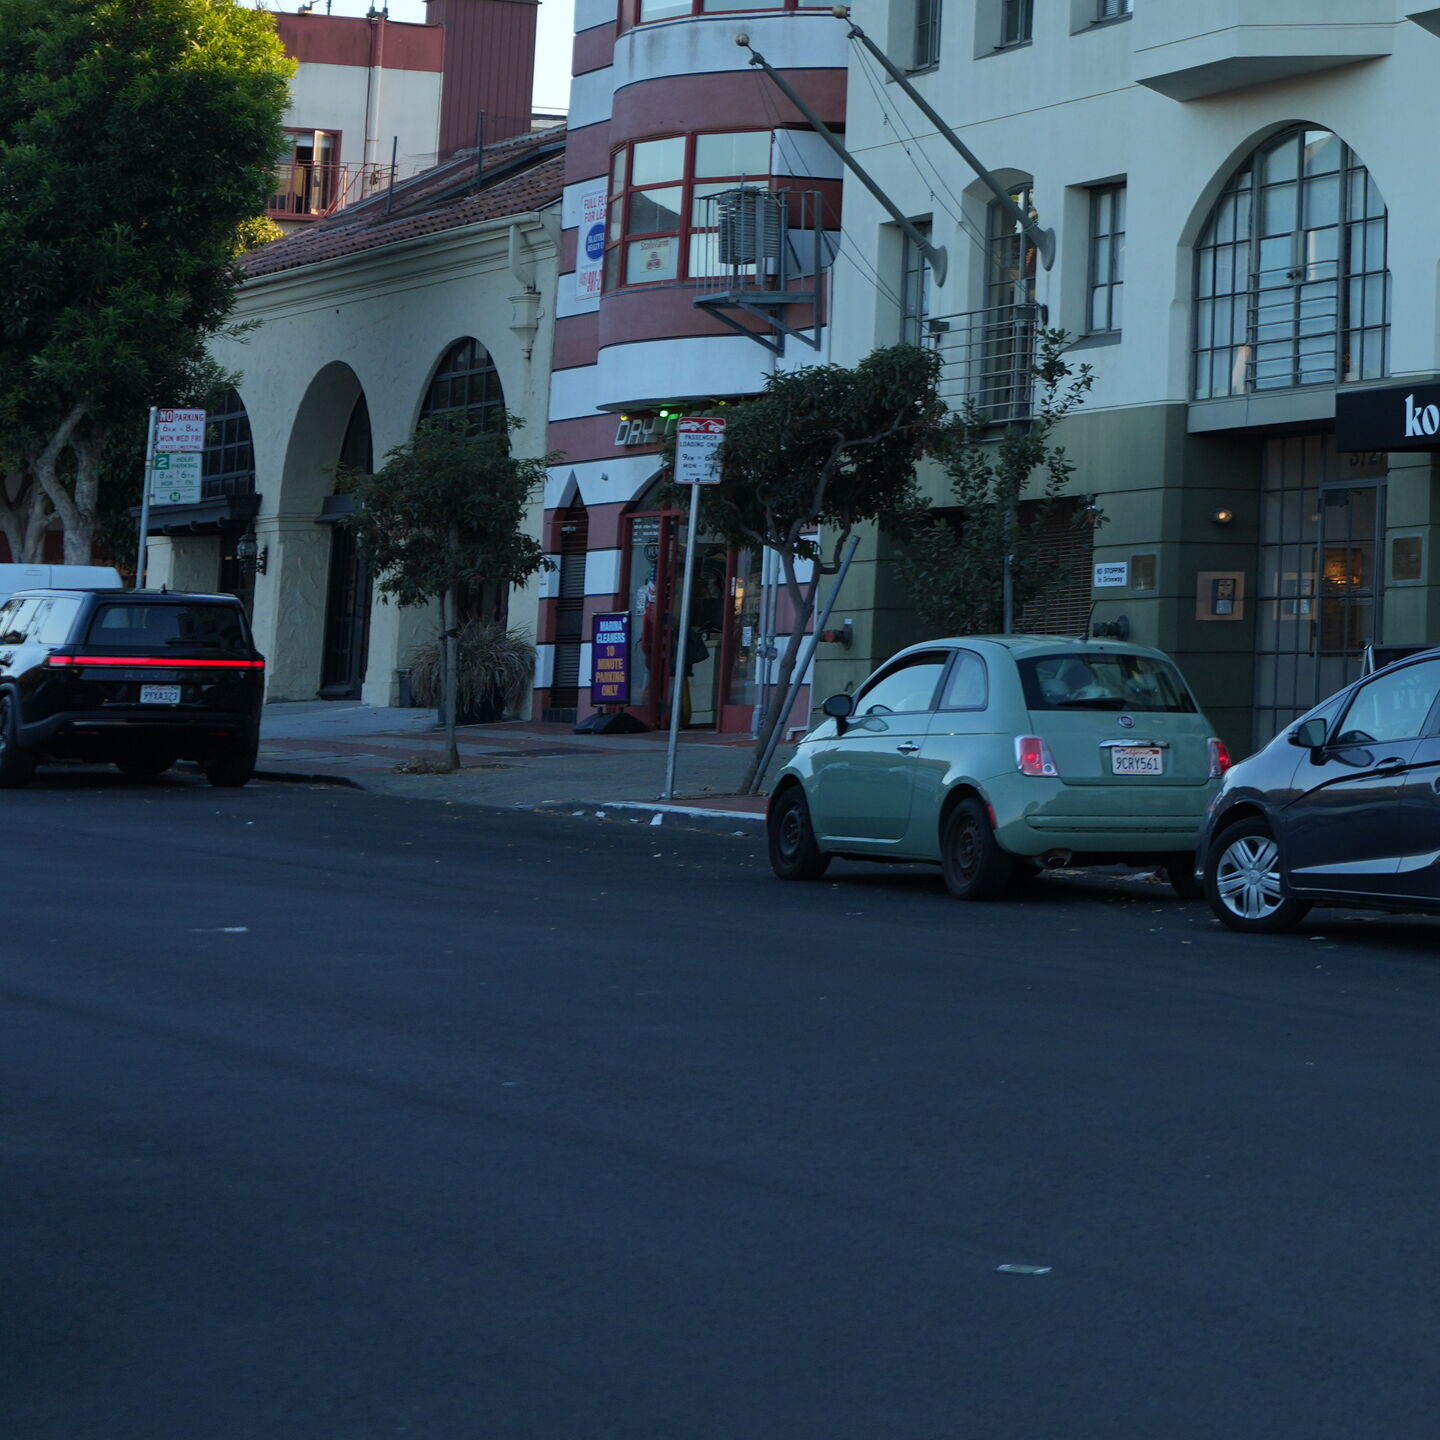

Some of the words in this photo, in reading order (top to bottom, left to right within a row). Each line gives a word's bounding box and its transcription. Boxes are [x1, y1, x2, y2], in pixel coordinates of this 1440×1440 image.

[160, 410, 173, 422] NO
[174, 413, 205, 422] PARKING
[614, 417, 660, 446] DRY
[160, 435, 175, 443] MON
[176, 434, 190, 442] WED
[158, 458, 168, 468] 2
[599, 620, 622, 632] MARINA
[596, 633, 626, 644] CLEANERS
[606, 645, 615, 656] 10
[597, 658, 624, 670] MINUTE
[595, 671, 625, 683] PARKING
[602, 684, 618, 697] ONLY
[1115, 756, 1159, 771] 9CRY561
